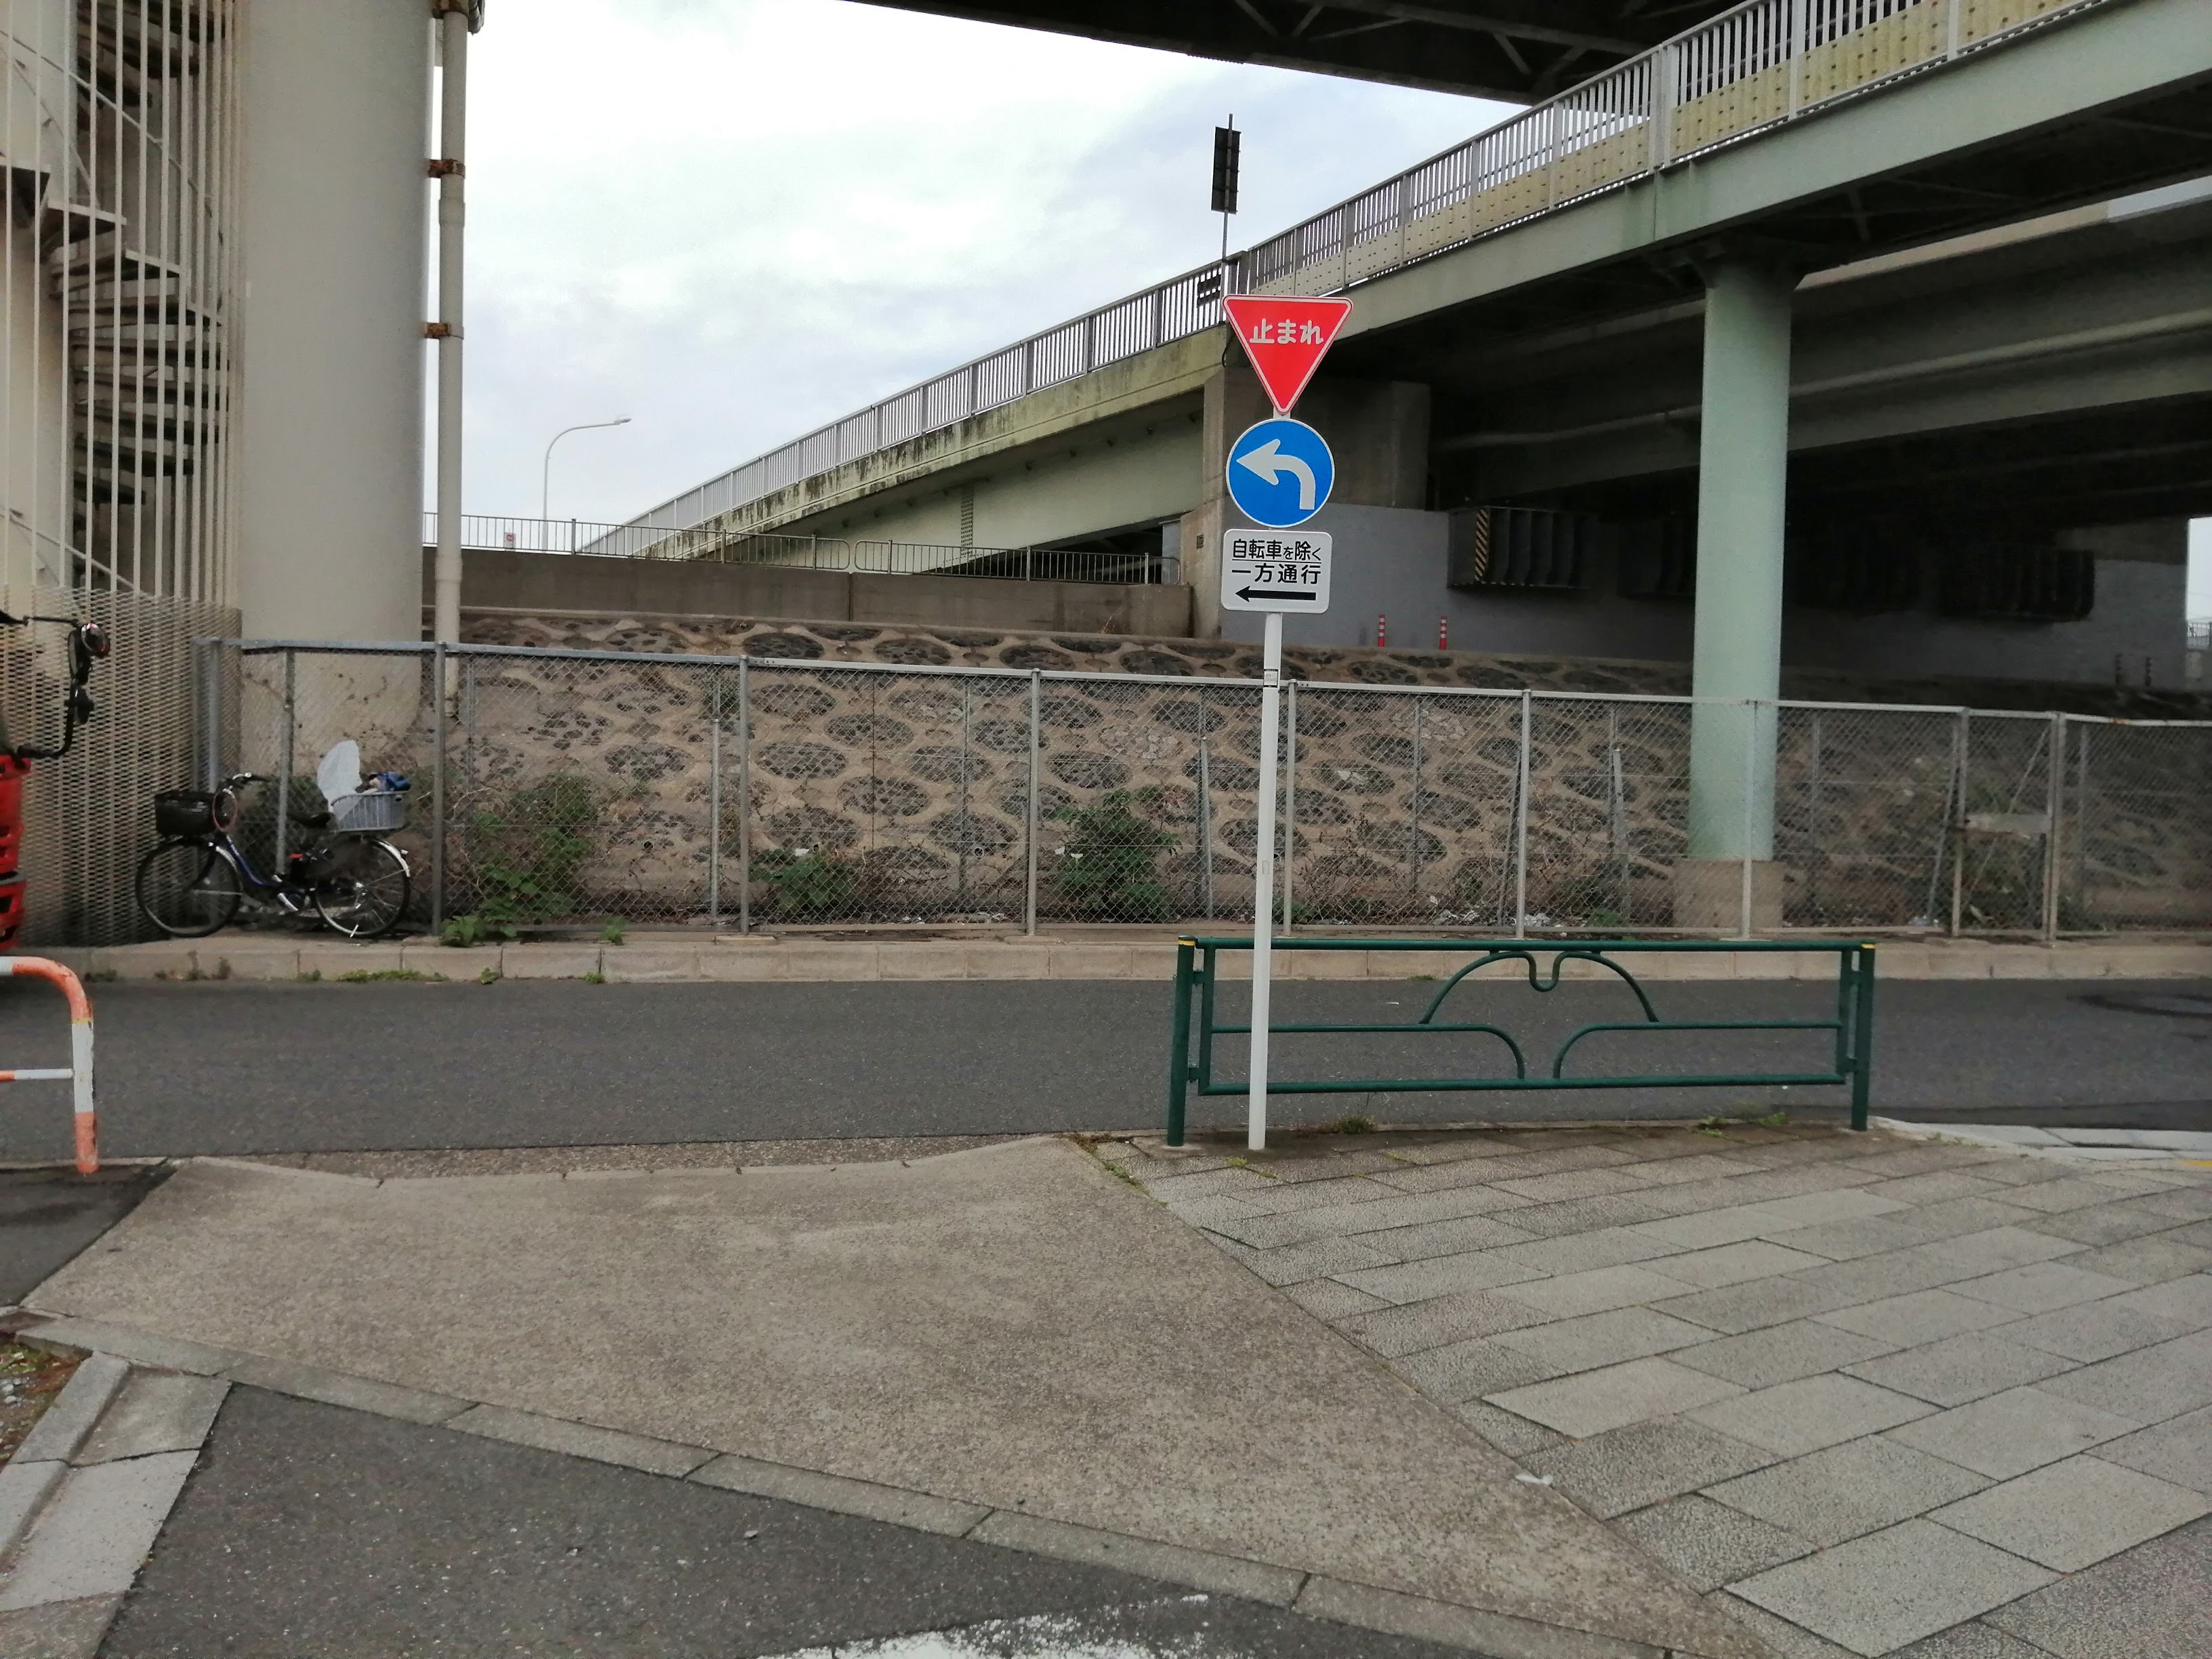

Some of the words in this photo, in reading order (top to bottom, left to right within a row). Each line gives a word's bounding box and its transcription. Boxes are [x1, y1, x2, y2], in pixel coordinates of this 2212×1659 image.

[1249, 318, 1324, 345] 止まれ
[1233, 539, 1322, 561] 自転車を除く
[1231, 562, 1322, 584] 一方通行
